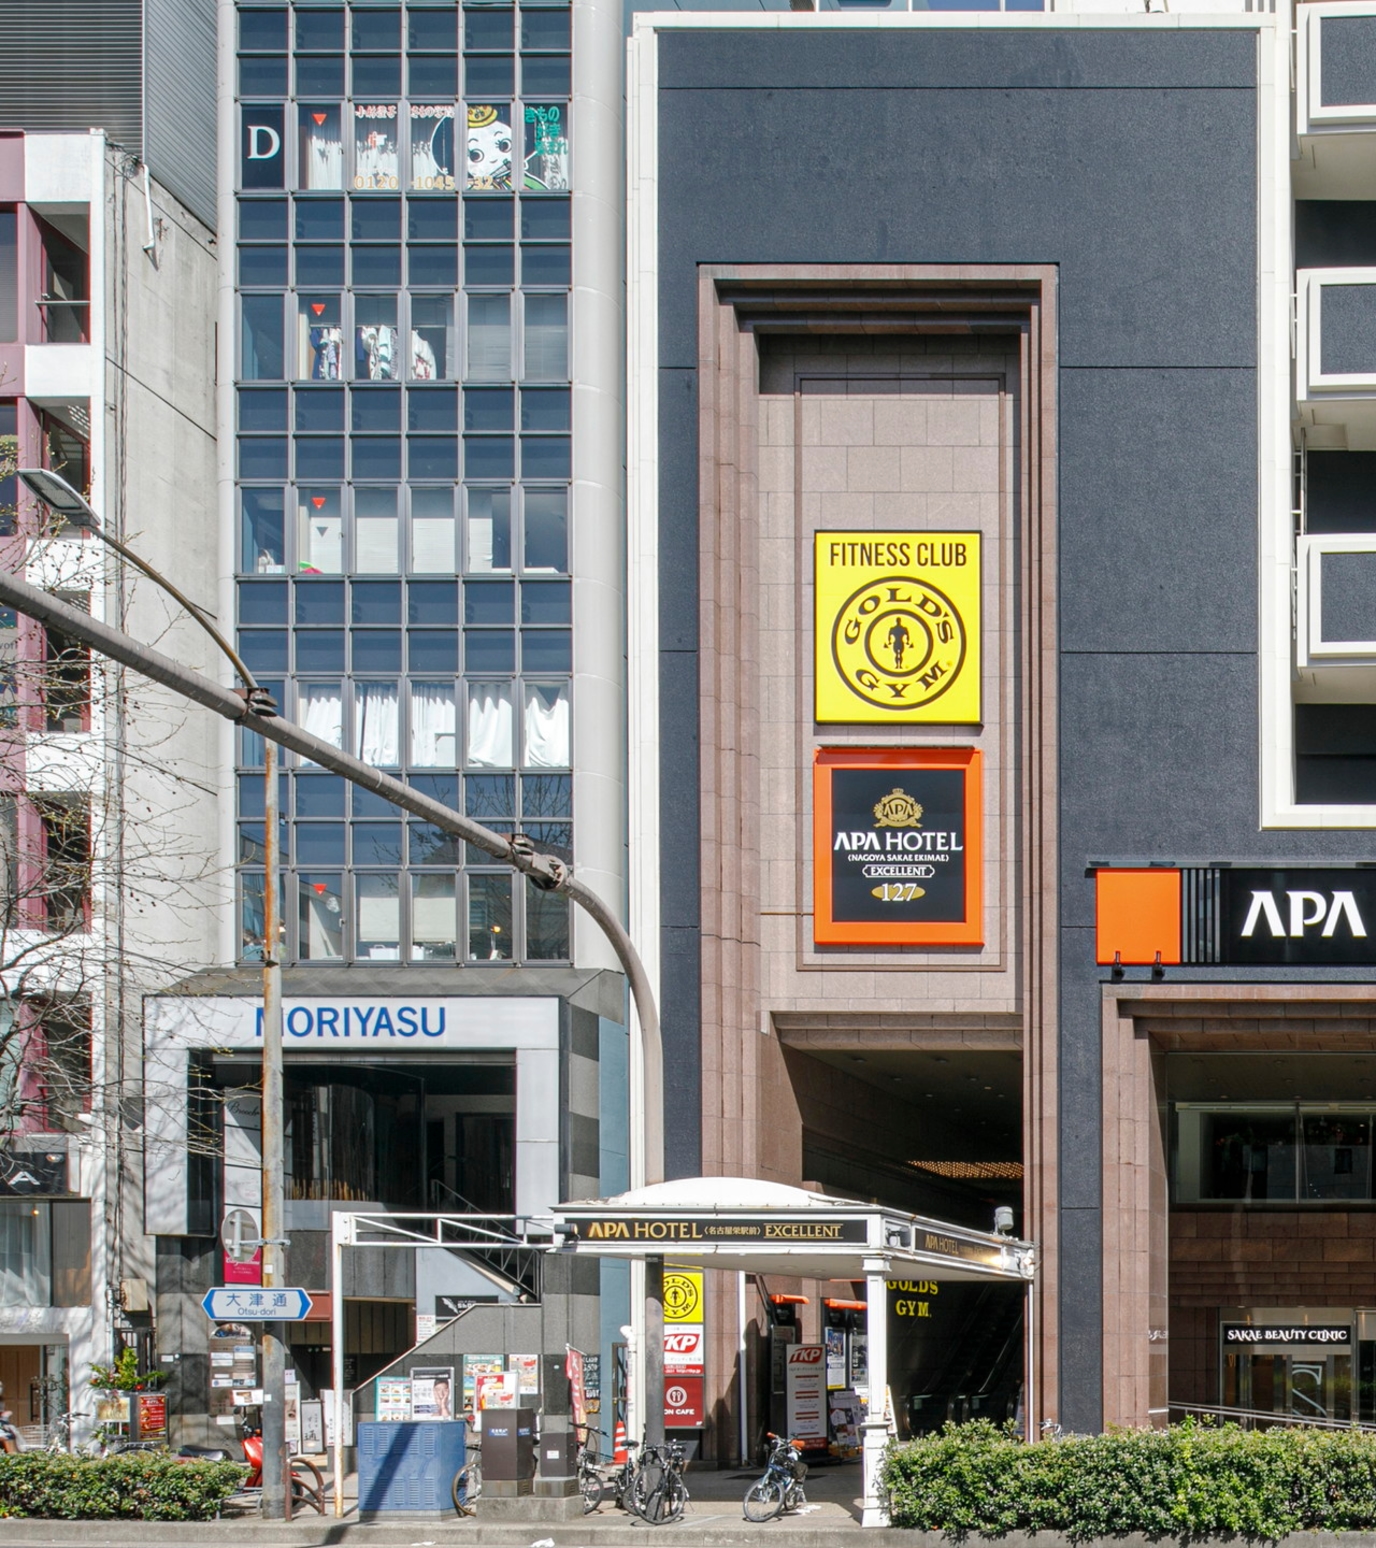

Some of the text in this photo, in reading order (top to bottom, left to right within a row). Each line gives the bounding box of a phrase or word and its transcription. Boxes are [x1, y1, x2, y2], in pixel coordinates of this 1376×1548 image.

[247, 126, 280, 159] D
[830, 543, 967, 566] FITNESS CLUB
[844, 588, 954, 645] GOLD'S
[855, 660, 947, 698] GYM
[884, 804, 914, 816] APA
[834, 832, 963, 851] APA HOTEL
[848, 854, 949, 862] (NAGOYA SAKAE EKIMAE)
[871, 867, 926, 876] EXCELLENT
[881, 882, 917, 901] 127
[1240, 890, 1367, 938] APA
[588, 1222, 630, 1238] APA
[634, 1222, 703, 1238] HOTEL
[765, 1225, 841, 1238] EXCELLENT
[925, 1234, 939, 1250] APA
[939, 1236, 959, 1255] HOTEL
[226, 1293, 287, 1307] 大津通
[895, 1299, 929, 1317] GYM
[238, 1307, 276, 1316] Otsu-dori
[1228, 1329, 1347, 1342] SAKAE BEAUTY CLINIC
[793, 1349, 820, 1361] TKP
